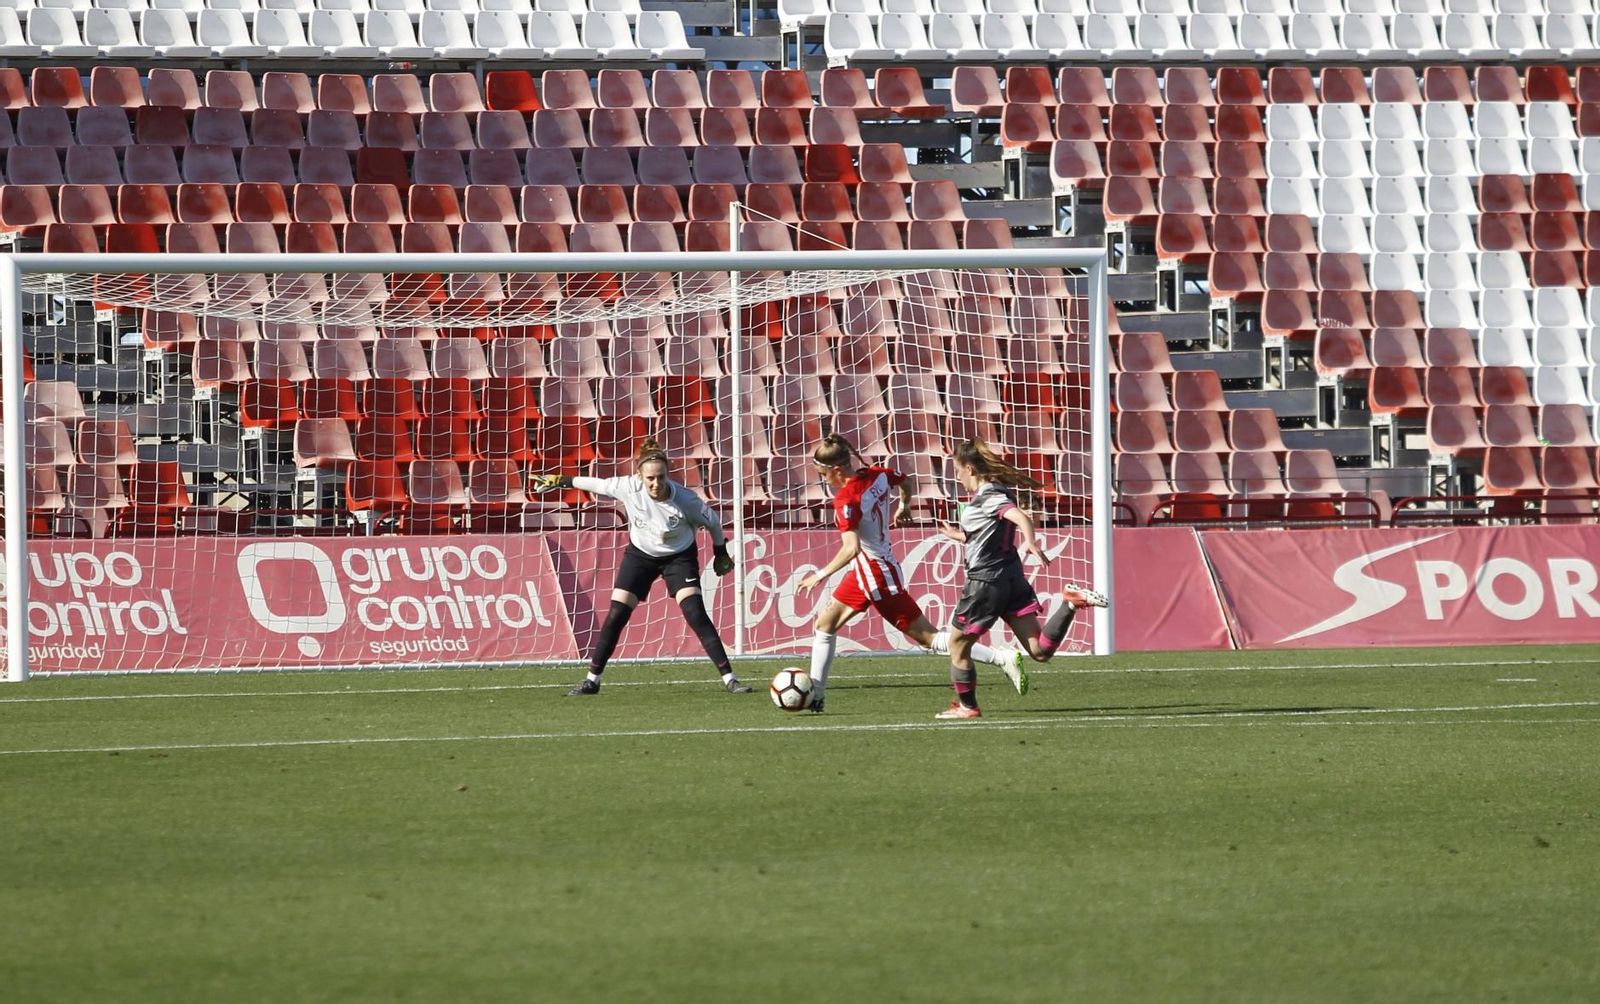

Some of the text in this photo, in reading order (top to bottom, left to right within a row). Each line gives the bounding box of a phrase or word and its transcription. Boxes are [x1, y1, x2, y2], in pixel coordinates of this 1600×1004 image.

[28, 551, 142, 598] upo
[341, 545, 508, 595] grupo
[27, 588, 188, 637] ontrol
[357, 580, 552, 631] control
[27, 642, 102, 663] guridad
[369, 636, 470, 657] seguridad
